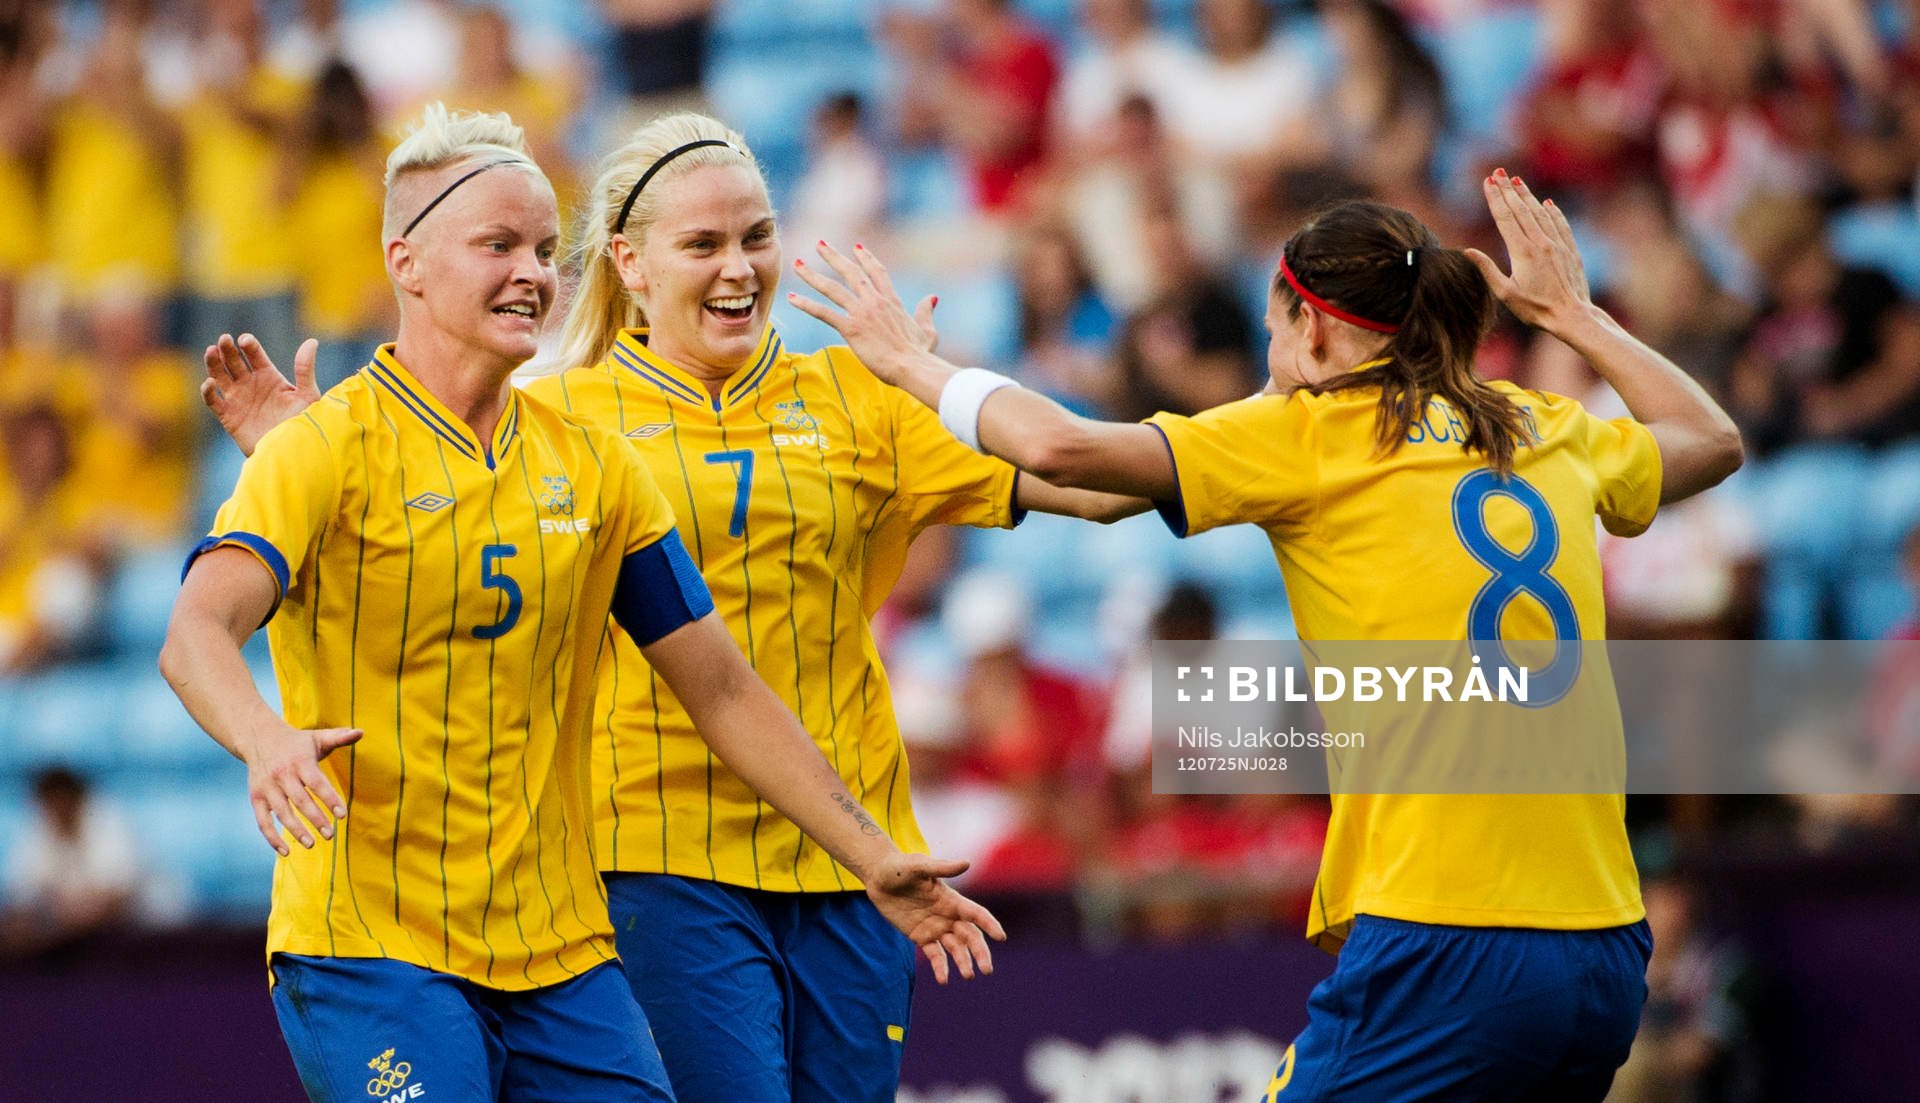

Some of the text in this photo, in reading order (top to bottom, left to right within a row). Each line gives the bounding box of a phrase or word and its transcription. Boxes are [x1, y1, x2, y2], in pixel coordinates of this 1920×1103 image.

[772, 434, 830, 450] SWE
[539, 517, 590, 534] SWE
[703, 449, 754, 538] 7
[472, 544, 522, 639] 5
[1451, 467, 1582, 709] 8
